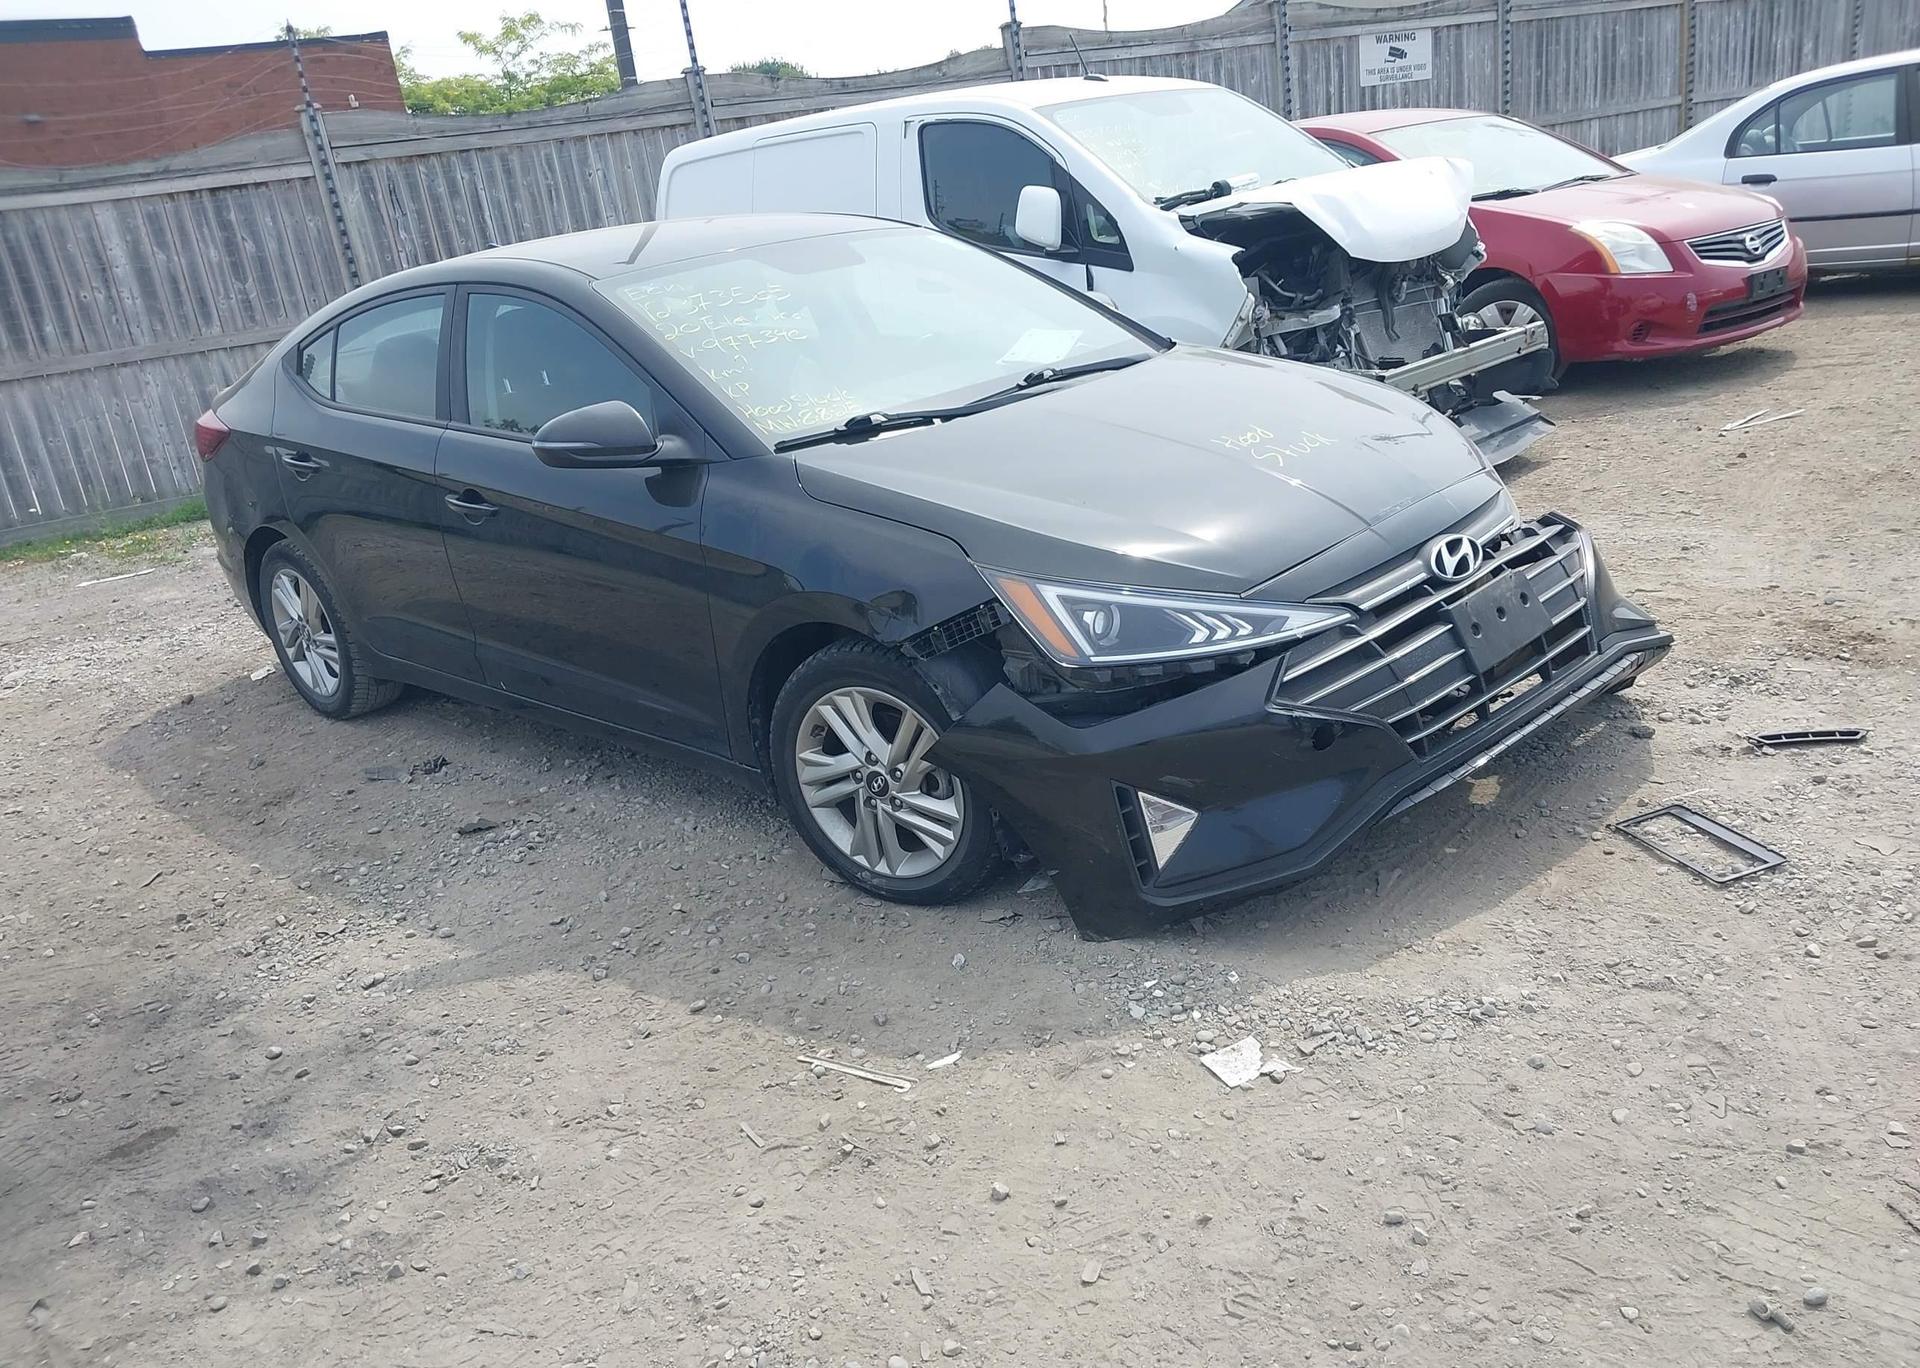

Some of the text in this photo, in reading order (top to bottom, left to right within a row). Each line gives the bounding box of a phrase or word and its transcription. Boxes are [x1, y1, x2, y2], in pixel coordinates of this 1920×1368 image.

[1376, 32, 1416, 45] WARNING
[1365, 63, 1427, 76] THIS AREA IS UNDER VIDEO
[1379, 72, 1414, 83] SURVEILLANCE
